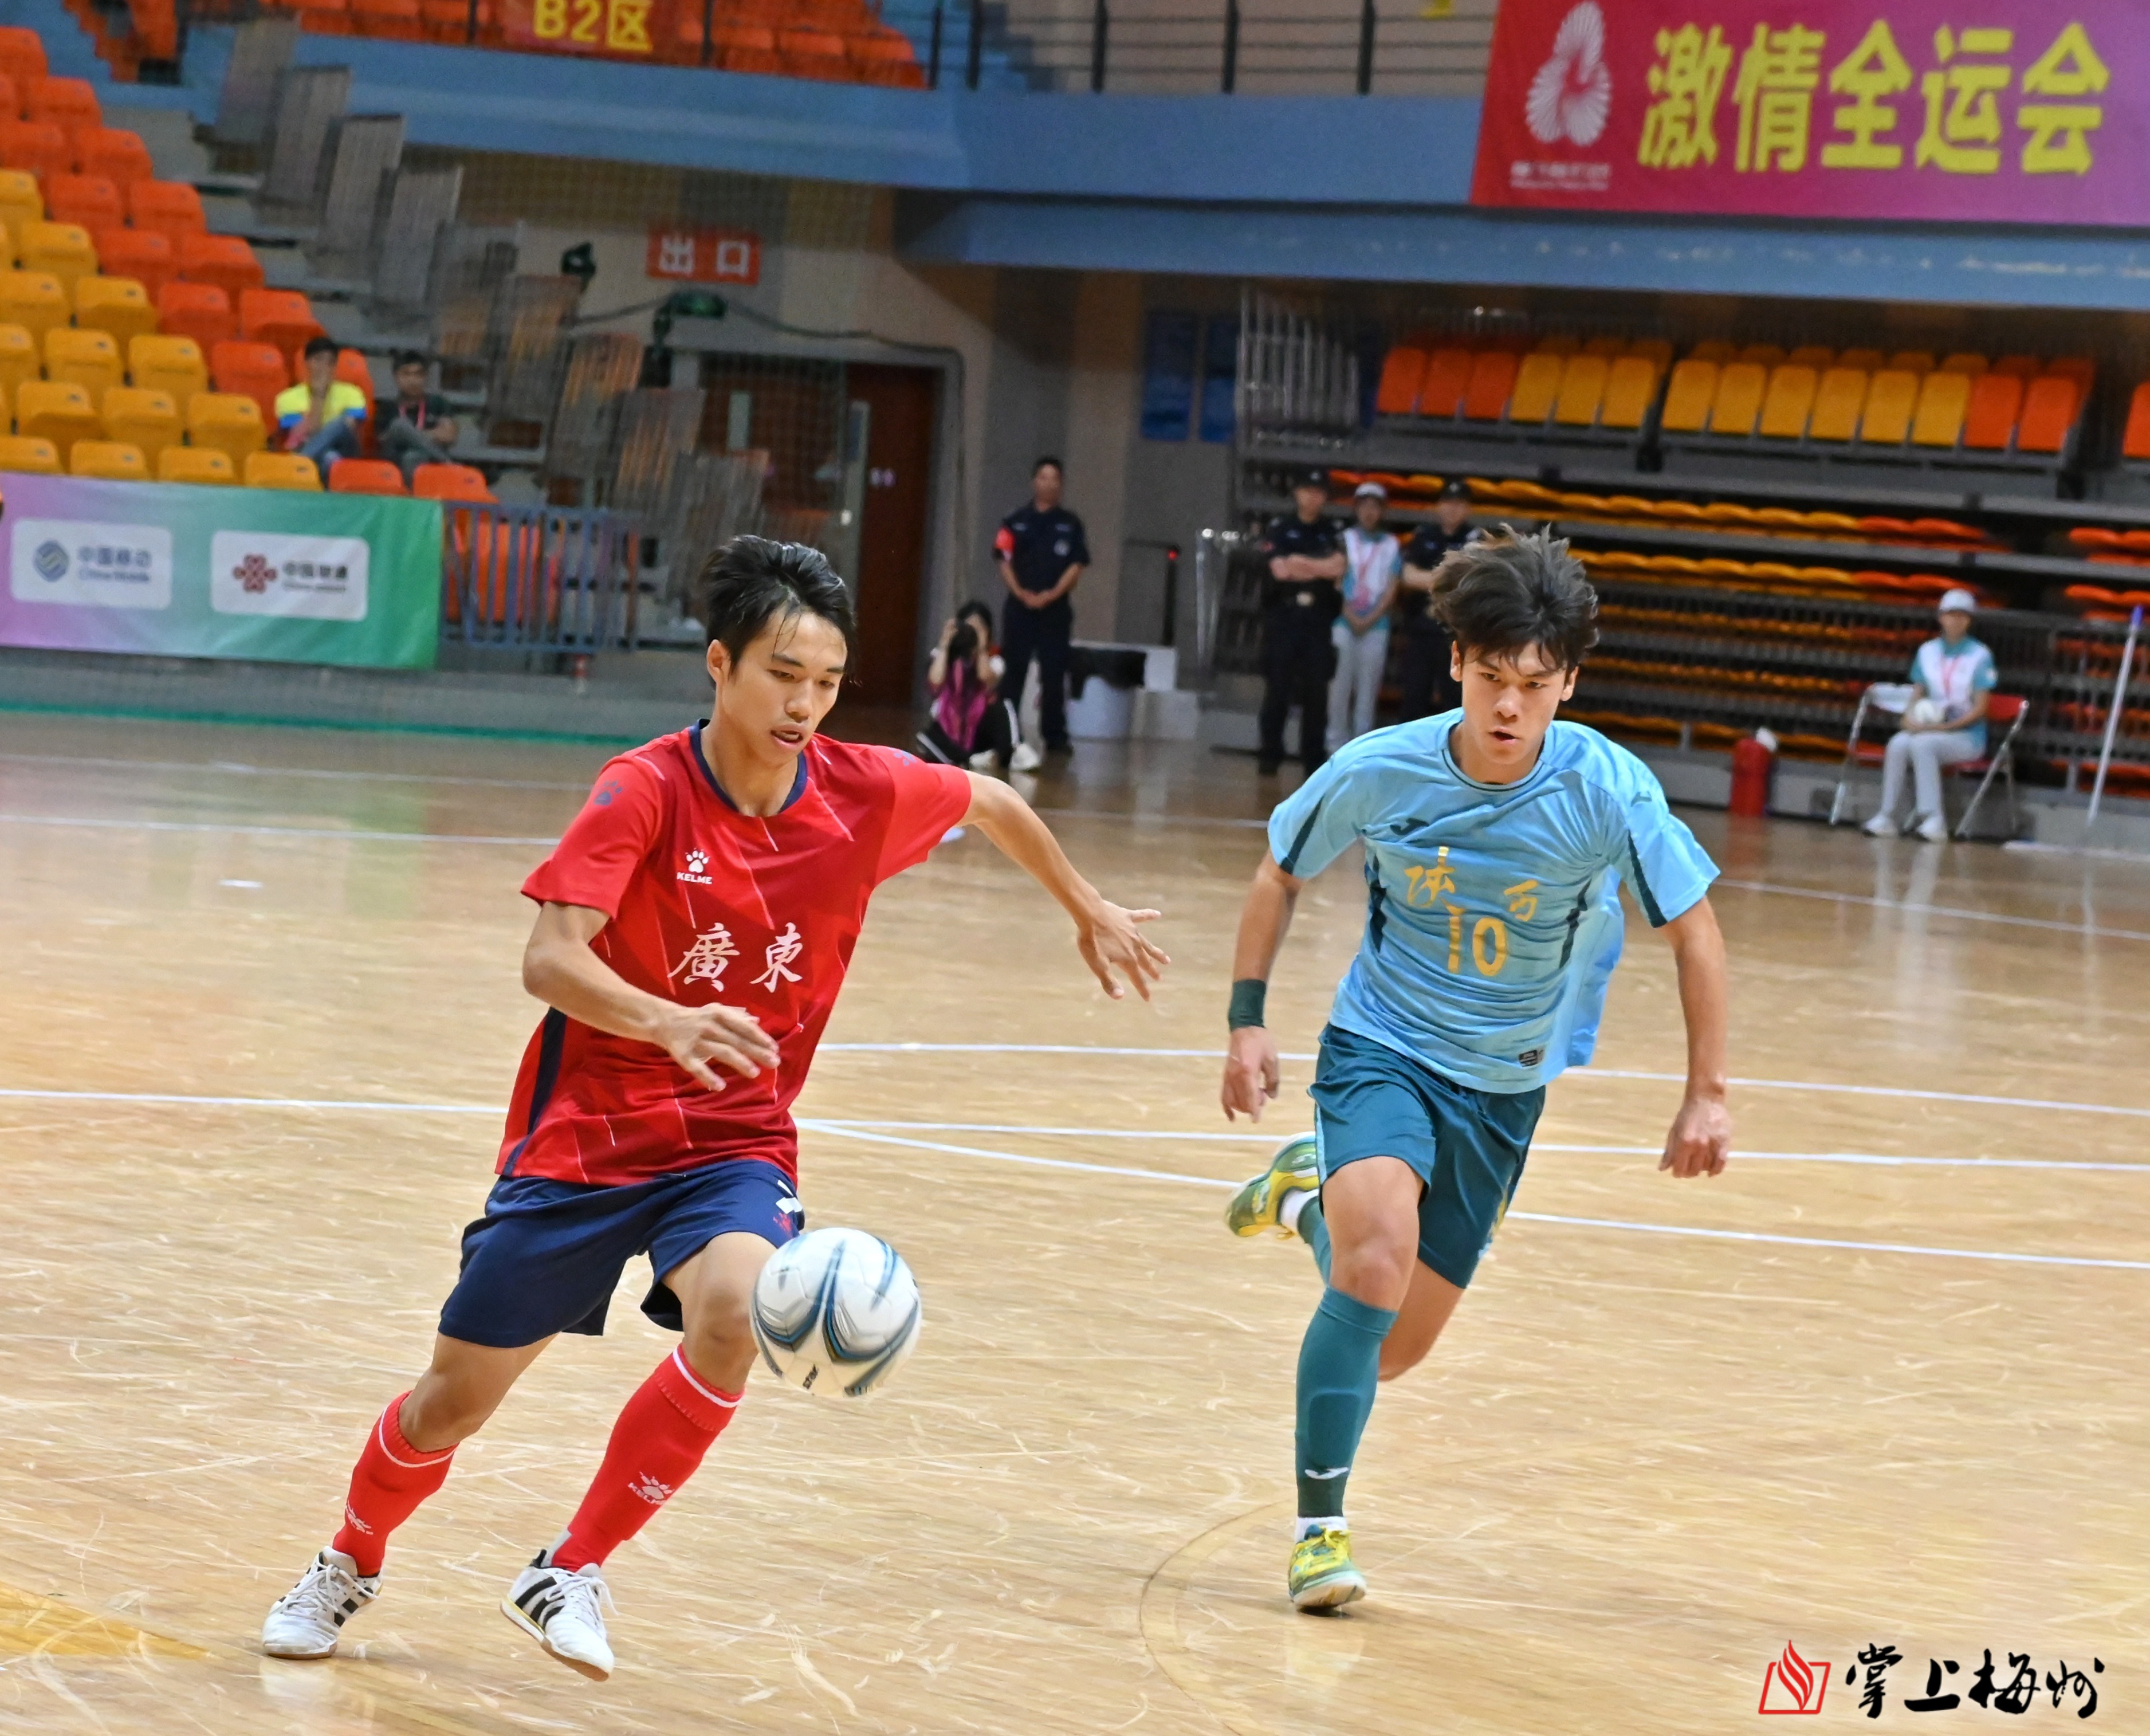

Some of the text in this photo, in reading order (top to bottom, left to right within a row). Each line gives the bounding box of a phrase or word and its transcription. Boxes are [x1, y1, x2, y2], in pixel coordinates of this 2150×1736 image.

[534, 0, 653, 52] B2区
[1636, 19, 2112, 176] 激情全运会
[659, 231, 750, 278] 出口
[677, 871, 713, 885] KELME
[667, 922, 803, 993] 廣東
[1447, 914, 1509, 977] 10
